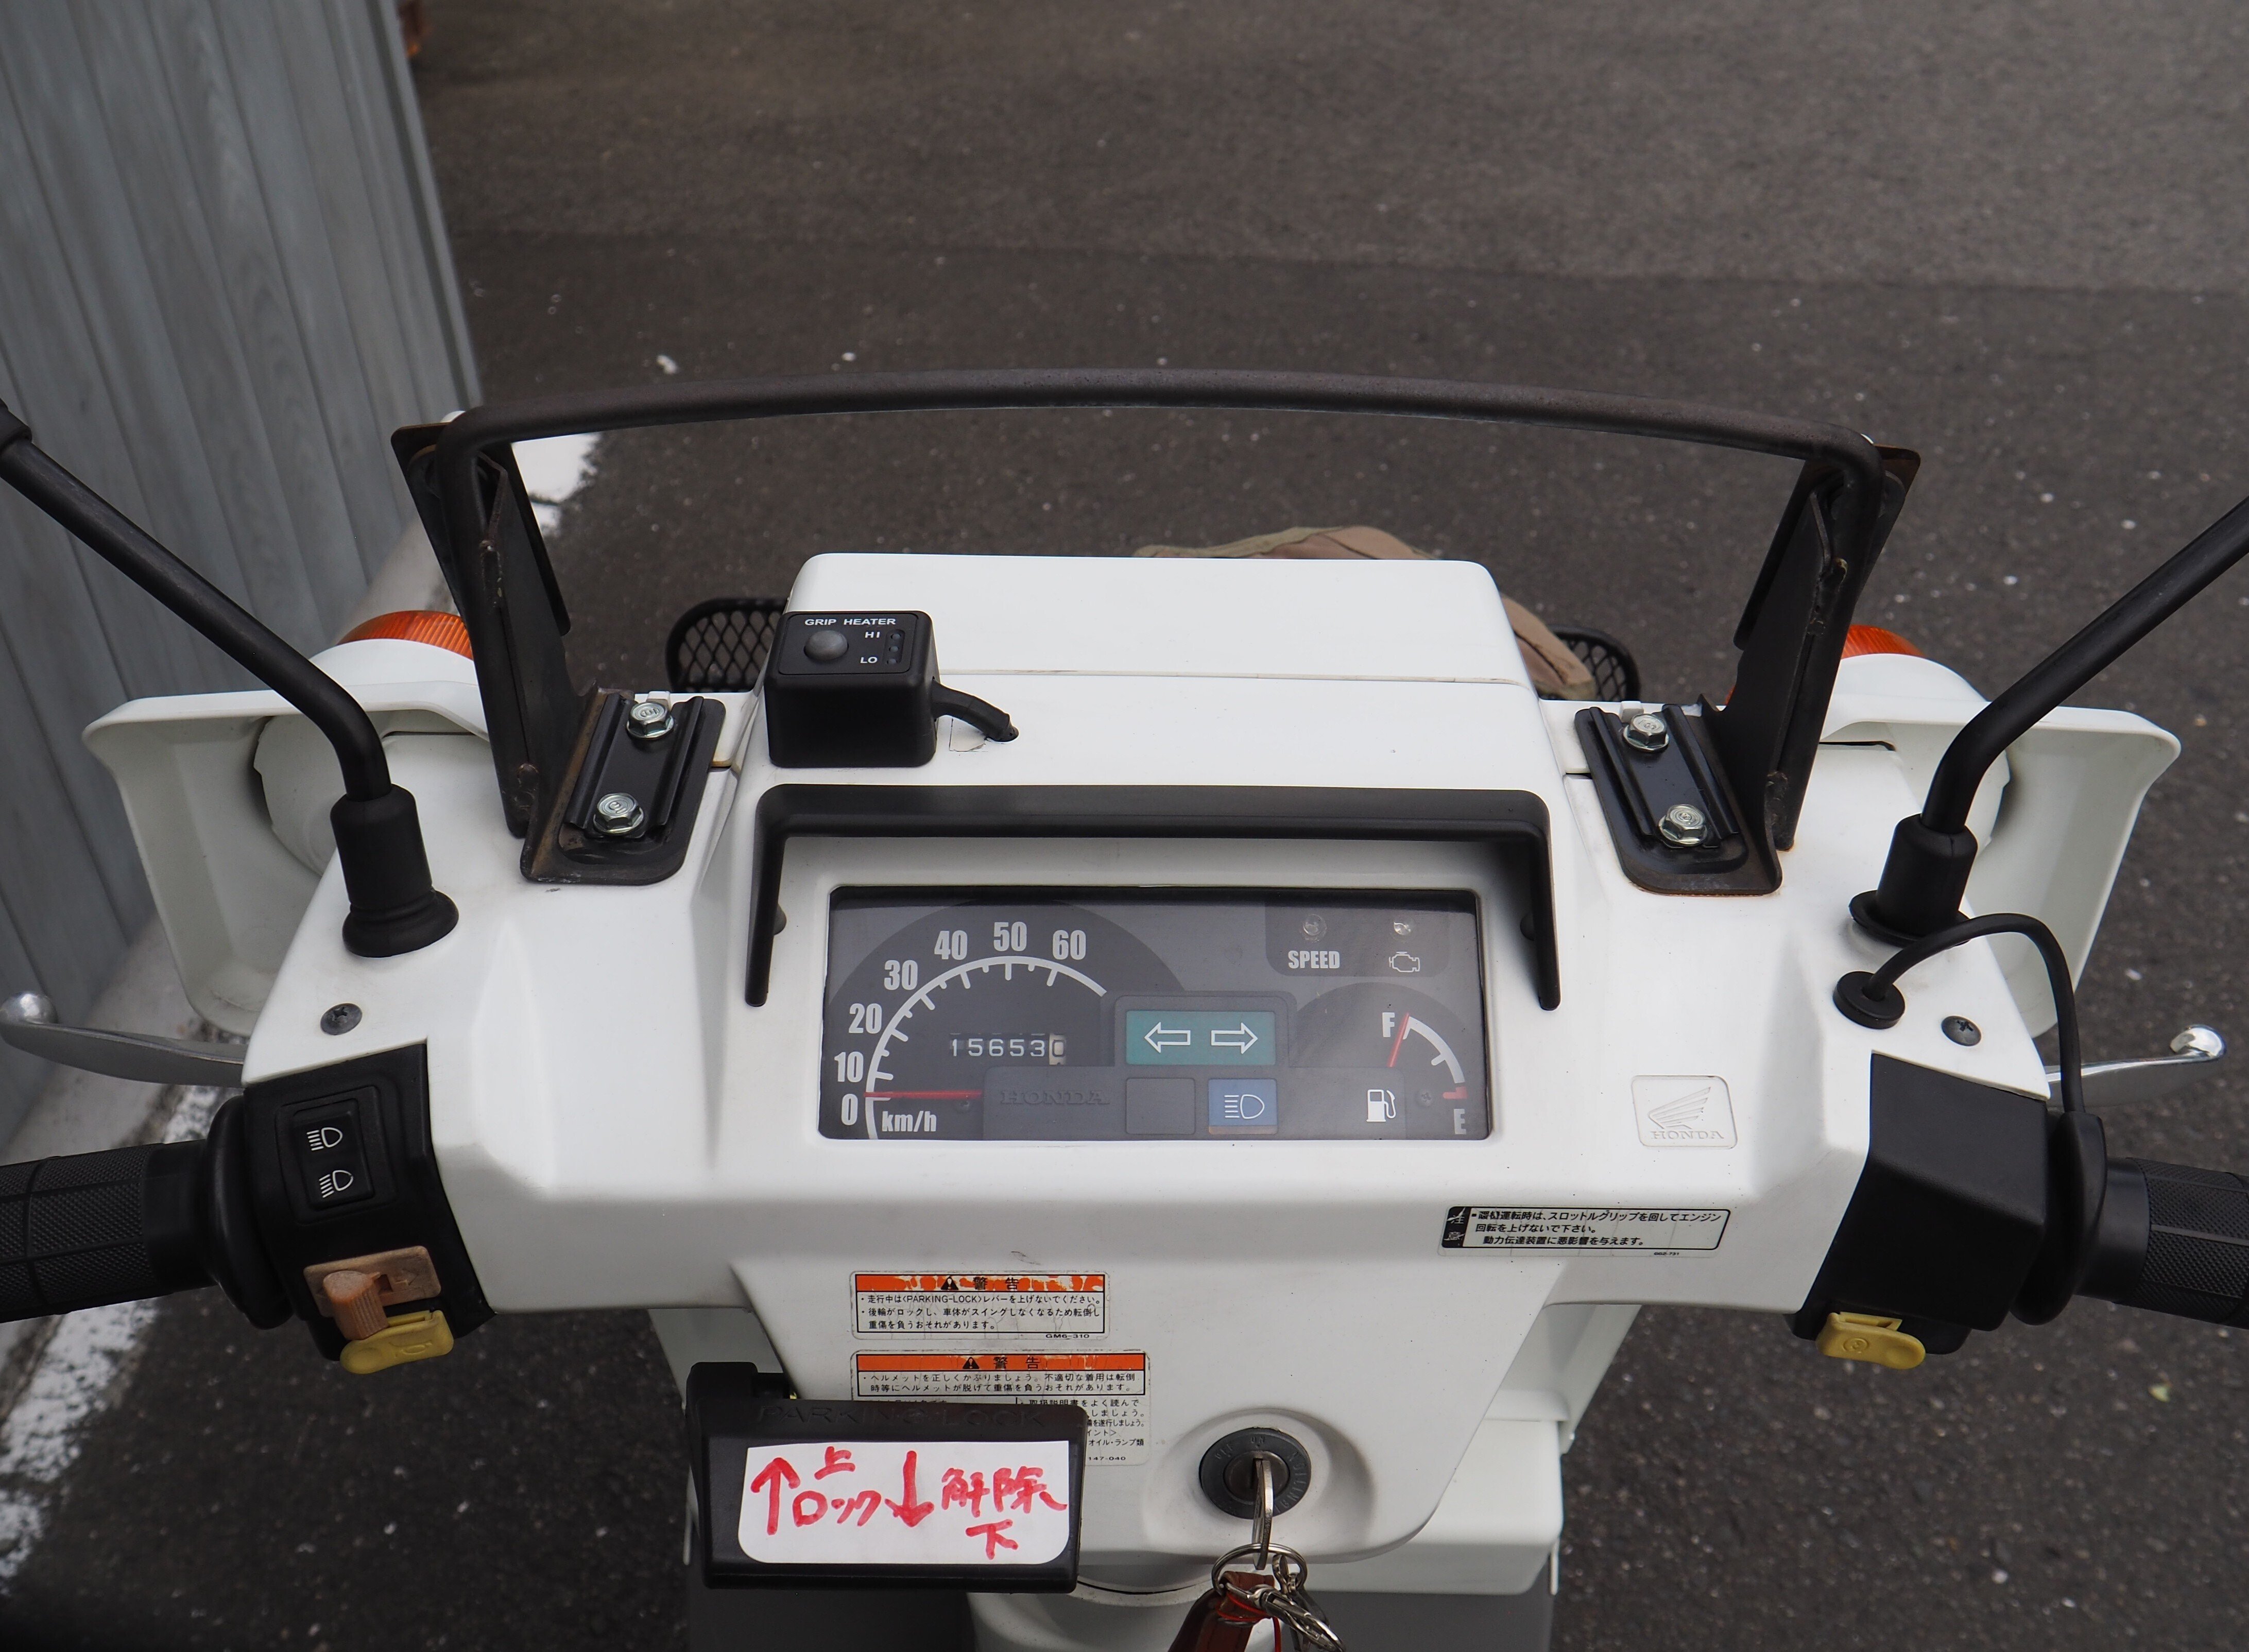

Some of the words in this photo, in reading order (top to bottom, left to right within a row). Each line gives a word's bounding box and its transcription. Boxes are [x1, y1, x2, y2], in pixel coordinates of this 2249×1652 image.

[934, 930, 967, 960] 40
[993, 922, 1027, 952] 50
[1053, 930, 1086, 960] 60
[884, 960, 918, 990] 30
[1288, 951, 1340, 969] SPEED
[848, 1003, 882, 1034] 20
[1382, 1012, 1395, 1038] F
[834, 1052, 864, 1082] 10
[841, 1093, 859, 1125] 0
[1000, 1090, 1110, 1105] HONDA
[881, 1111, 937, 1132] km/h
[1453, 1108, 1467, 1134] E
[1650, 1131, 1725, 1140] HONDA
[993, 1356, 1040, 1369] 警告
[814, 1446, 855, 1480] 上
[941, 1466, 1067, 1517] 解除
[792, 1490, 882, 1527] ロック
[966, 1519, 1018, 1560] 下
